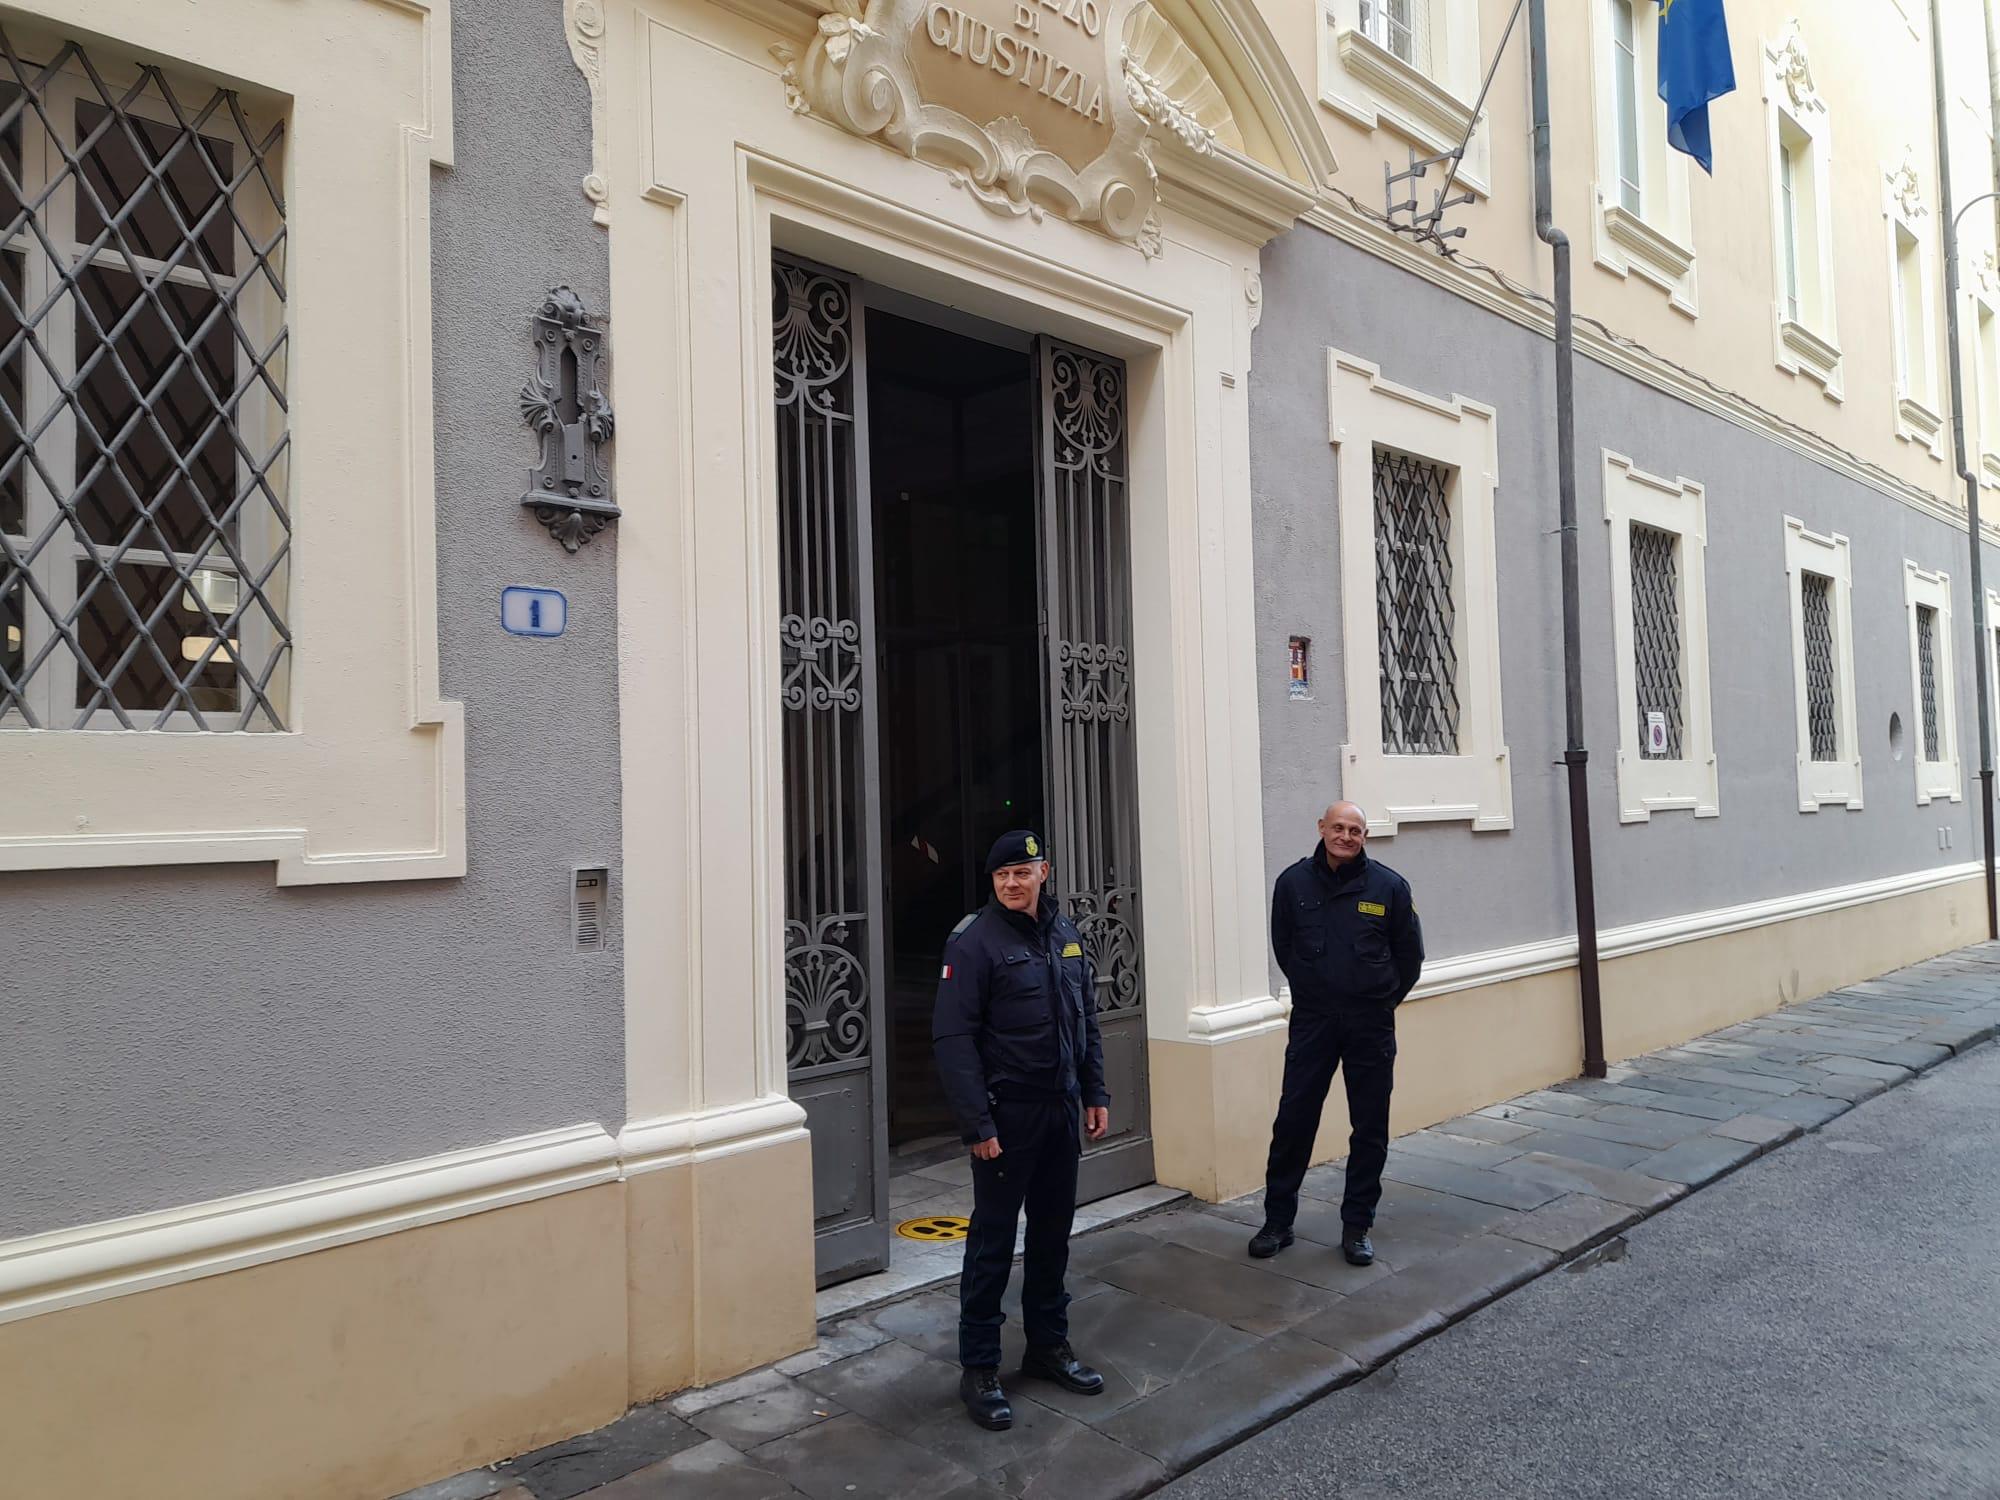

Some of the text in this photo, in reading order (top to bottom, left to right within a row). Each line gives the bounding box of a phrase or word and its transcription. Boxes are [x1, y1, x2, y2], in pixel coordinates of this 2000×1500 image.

[1014, 2, 1040, 35] DI
[927, 3, 1104, 124] GIUSTIZIA
[529, 599, 540, 627] 1
